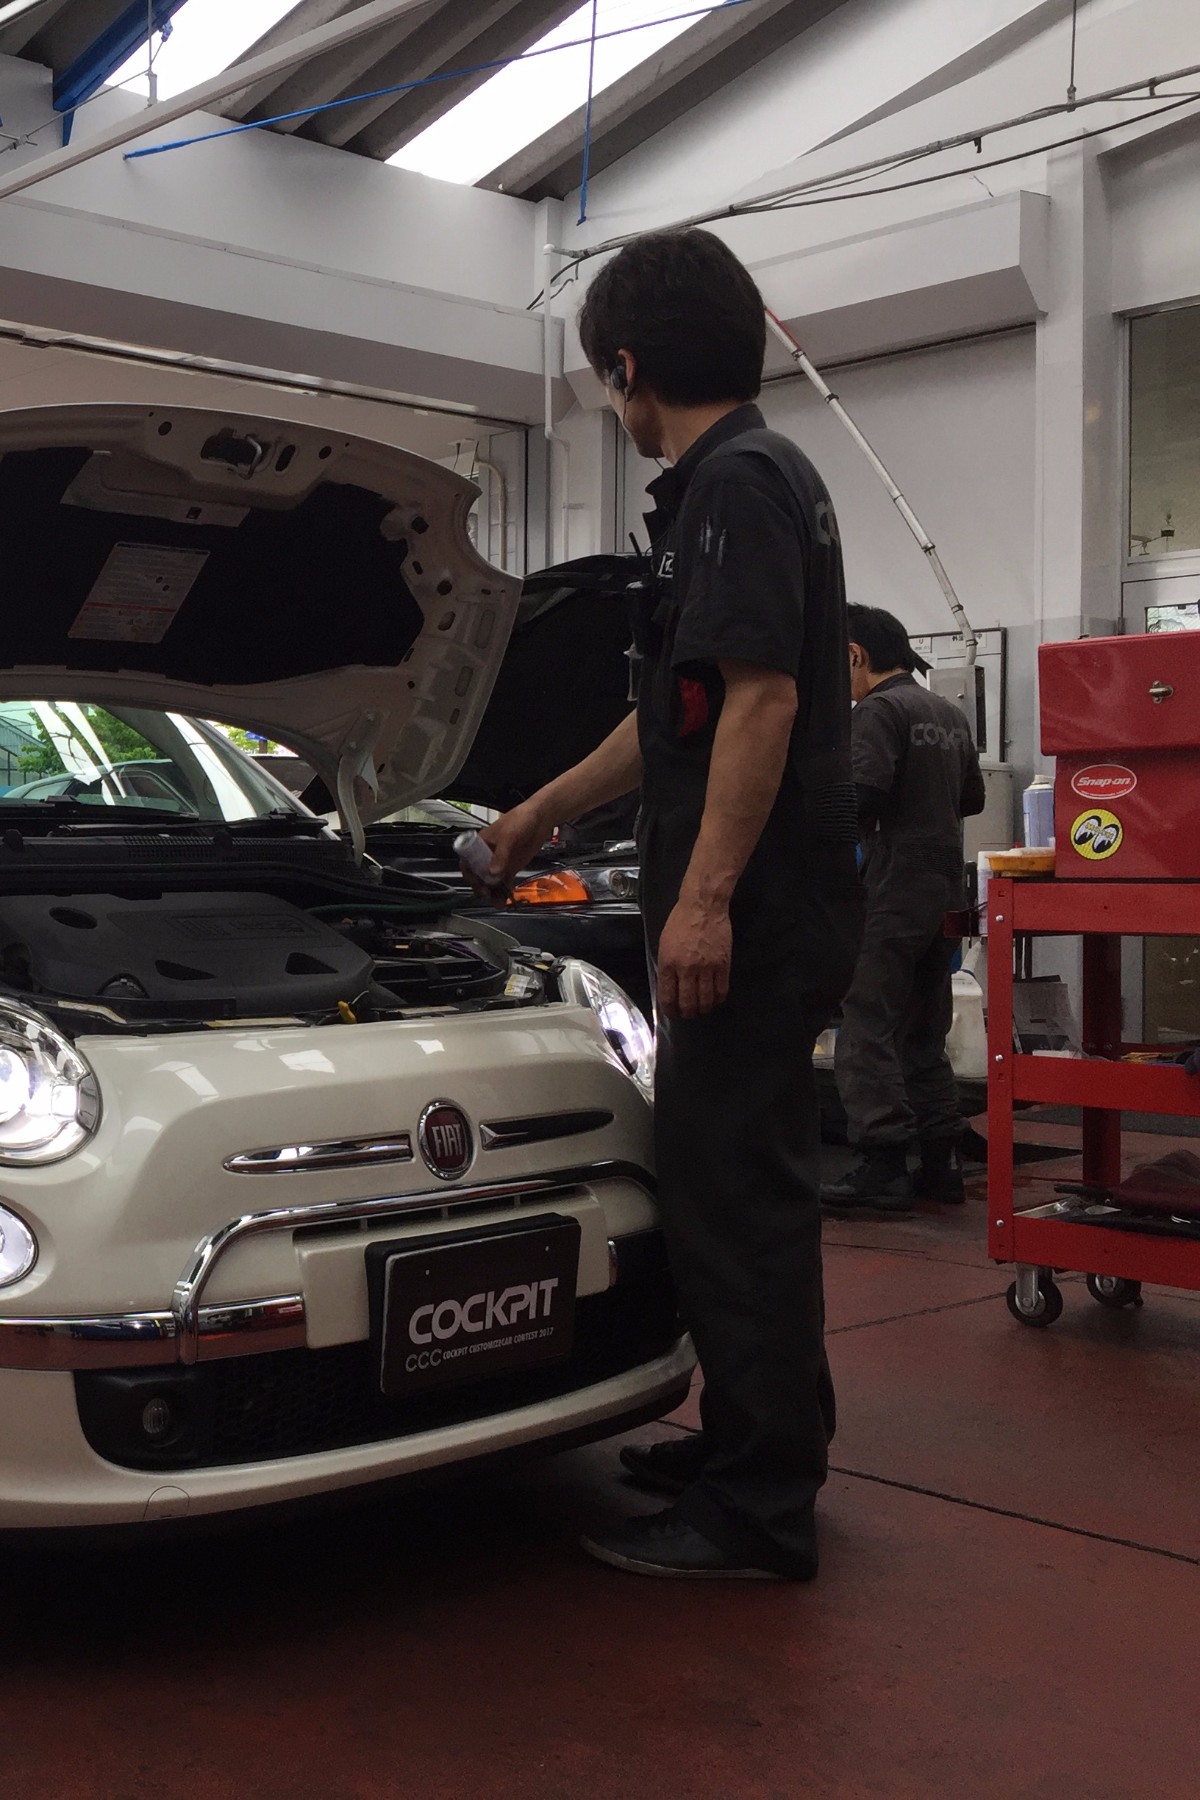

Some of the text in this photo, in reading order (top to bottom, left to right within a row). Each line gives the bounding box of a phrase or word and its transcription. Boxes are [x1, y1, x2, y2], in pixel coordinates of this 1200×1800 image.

[1077, 776, 1131, 788] Snap-on
[431, 1123, 463, 1158] FIAT
[408, 1277, 559, 1345] COCKPIT
[405, 1348, 442, 1373] CCC
[442, 1346, 468, 1360] COCKPIT
[513, 1330, 538, 1344] CONTEST
[538, 1327, 554, 1338] 2017
